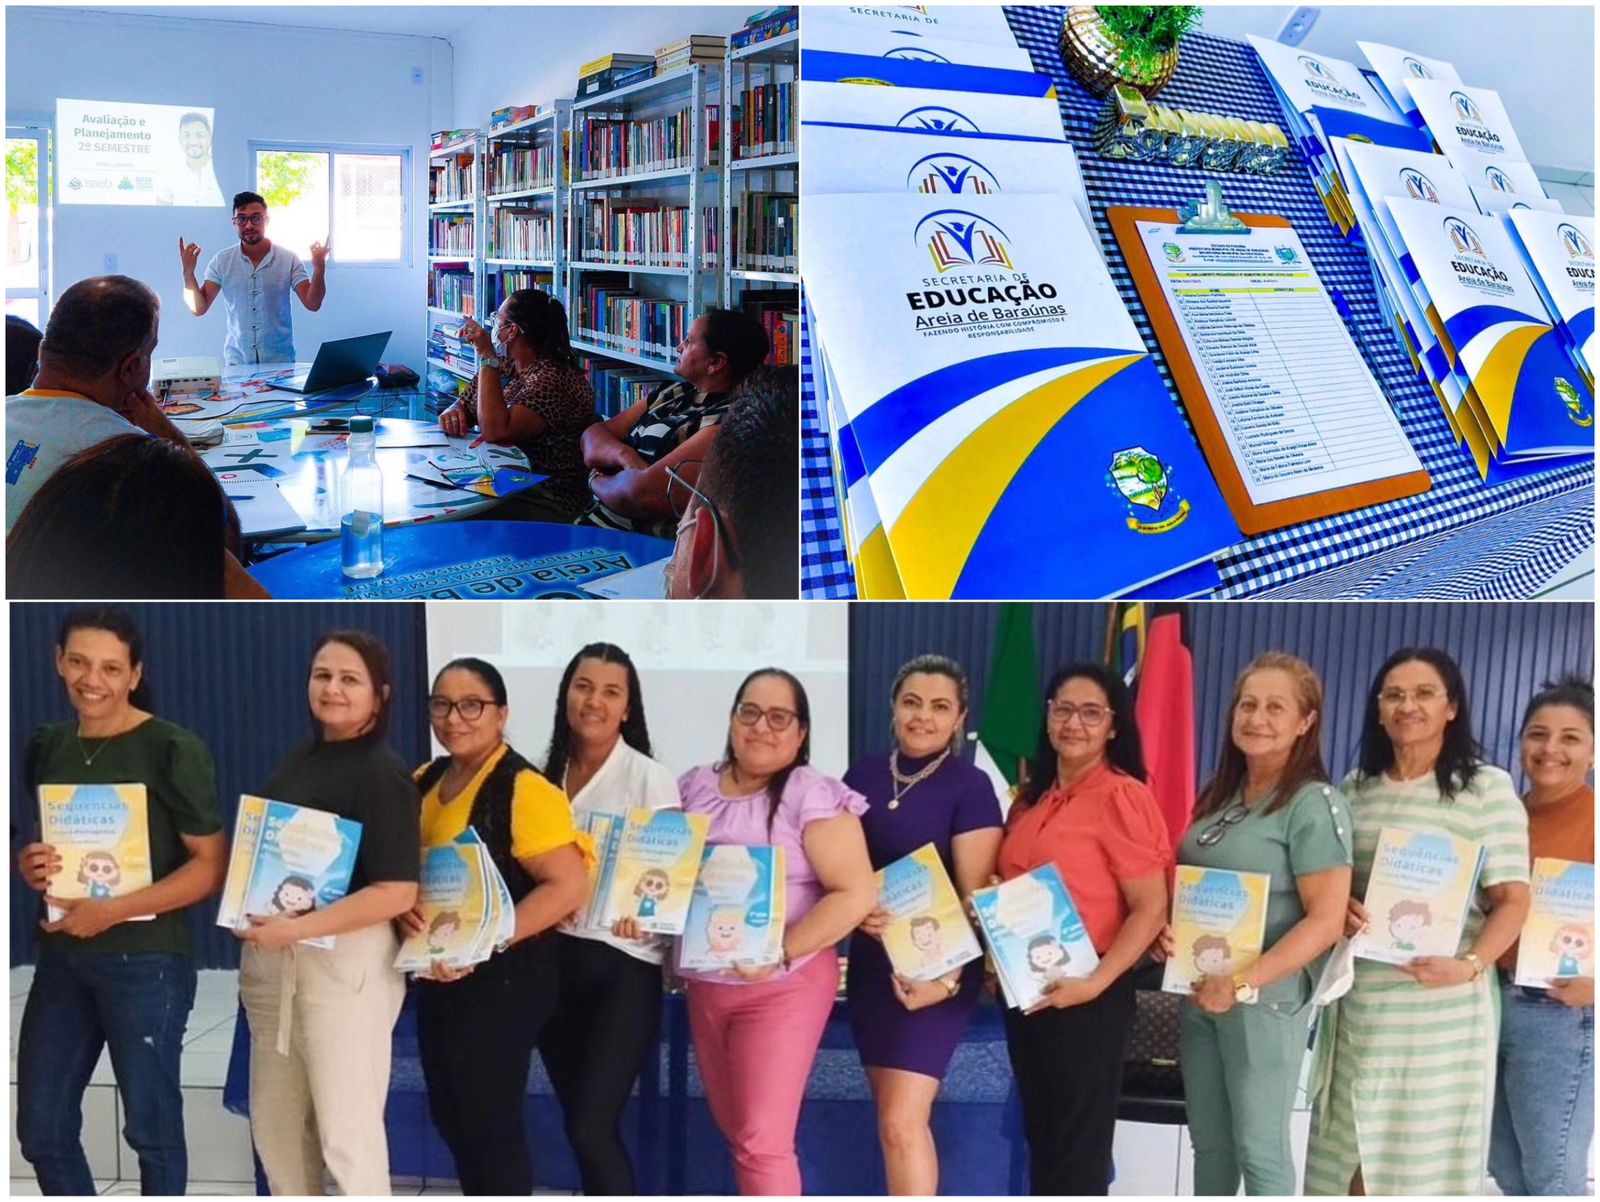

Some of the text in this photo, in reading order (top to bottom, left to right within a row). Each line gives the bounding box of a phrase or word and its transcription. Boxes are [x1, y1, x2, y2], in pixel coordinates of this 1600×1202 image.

[849, 6, 920, 24] SECRETARIA
[1305, 79, 1360, 100] EDUCAÇÃO
[82, 114, 136, 128] Avaliação
[74, 128, 152, 141] Planejamento
[1456, 126, 1500, 142] EDUCAÇÃO
[78, 142, 150, 154] 2º SEMESTRE
[1451, 260, 1508, 282] EDUCAÇÃO
[922, 272, 1028, 287] SECRETARIA DE
[1458, 274, 1476, 285] Areia
[1477, 278, 1484, 286] de
[906, 279, 1058, 311] EDUCAÇÃO
[915, 303, 1066, 328] Areia de Baraúnas
[923, 326, 960, 338] FAZENDO
[960, 322, 994, 333] HISTÓRIA
[995, 320, 1012, 329] COM
[1013, 316, 1060, 327] COMPROMISSO
[968, 326, 1036, 339] RESPONSABILIDADE
[534, 548, 606, 564] FAZENDO
[345, 556, 512, 593] RESPONSABILIDADE
[454, 561, 532, 580] HISTÓRIA
[530, 555, 633, 582] Areia
[411, 577, 449, 590] COM
[468, 576, 524, 594] de
[48, 801, 128, 812] Sequências
[48, 814, 116, 826] Didáticas
[630, 822, 693, 836] Sequências
[627, 834, 678, 847] Didáticas
[1383, 844, 1459, 864] Sequências
[1380, 857, 1443, 876] Didáticas
[1180, 882, 1250, 898] Sequências
[1180, 895, 1235, 910] Didáticas
